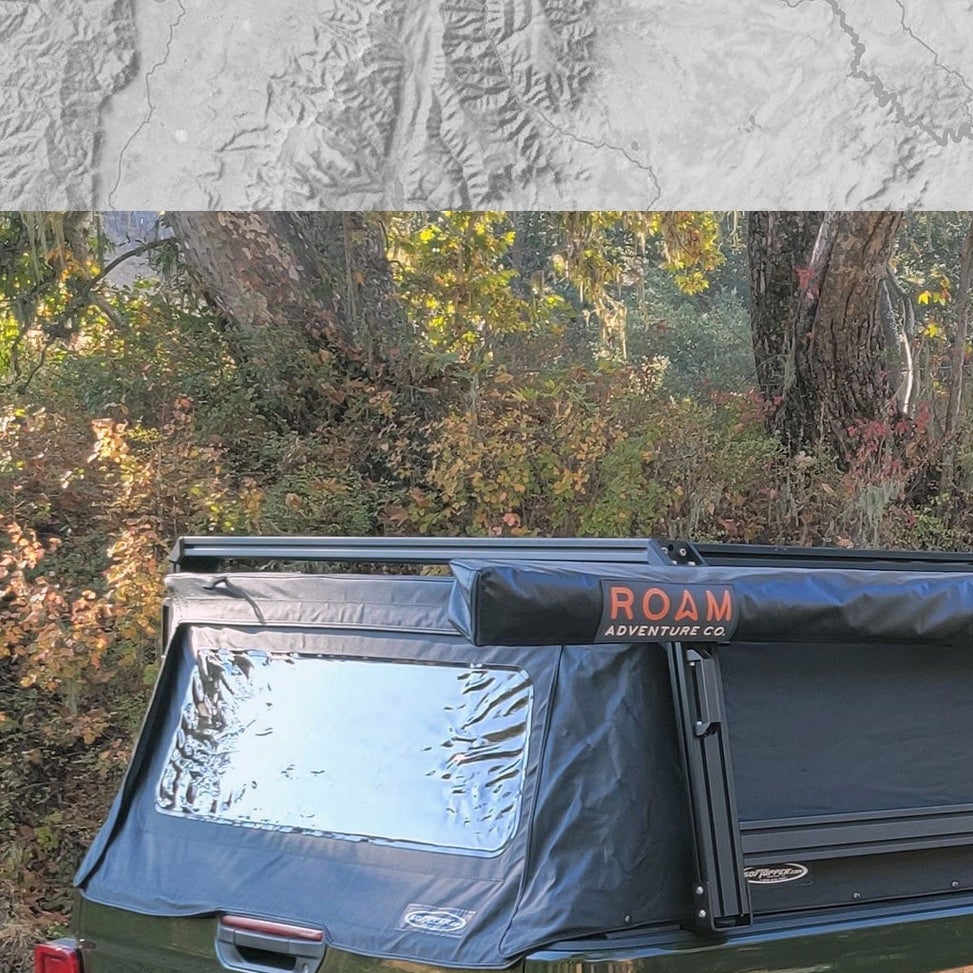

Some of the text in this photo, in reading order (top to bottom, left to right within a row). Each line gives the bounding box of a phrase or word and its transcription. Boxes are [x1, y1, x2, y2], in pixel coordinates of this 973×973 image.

[610, 586, 733, 621] ROAM
[604, 625, 726, 637] ADVENTURE CO.
